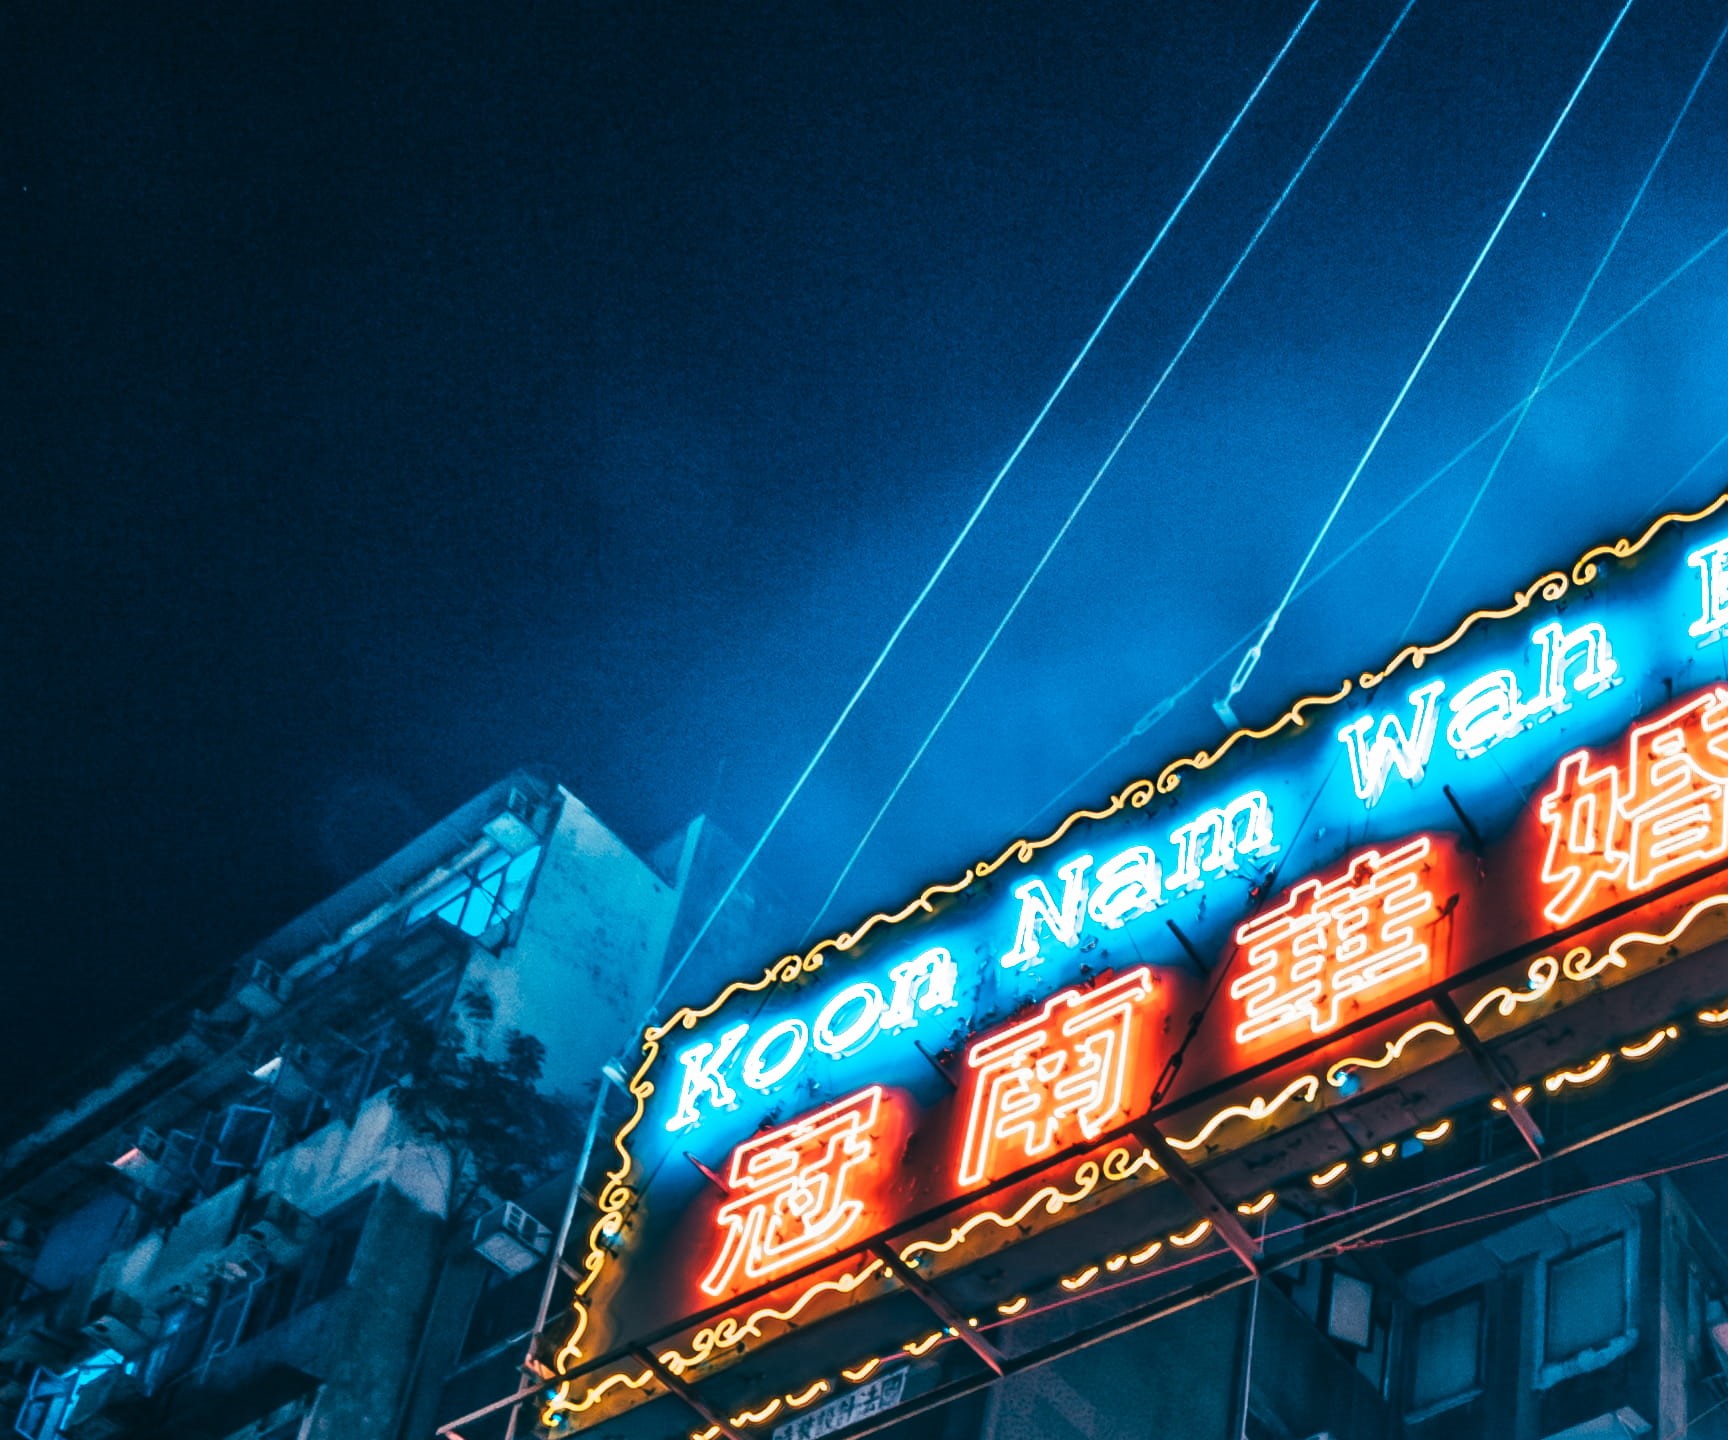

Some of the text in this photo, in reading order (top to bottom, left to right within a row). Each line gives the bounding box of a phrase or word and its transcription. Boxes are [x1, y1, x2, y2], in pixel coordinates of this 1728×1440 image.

[661, 931, 958, 1134] Koon
[1003, 786, 1277, 973] Nam
[1344, 619, 1622, 806] Wah
